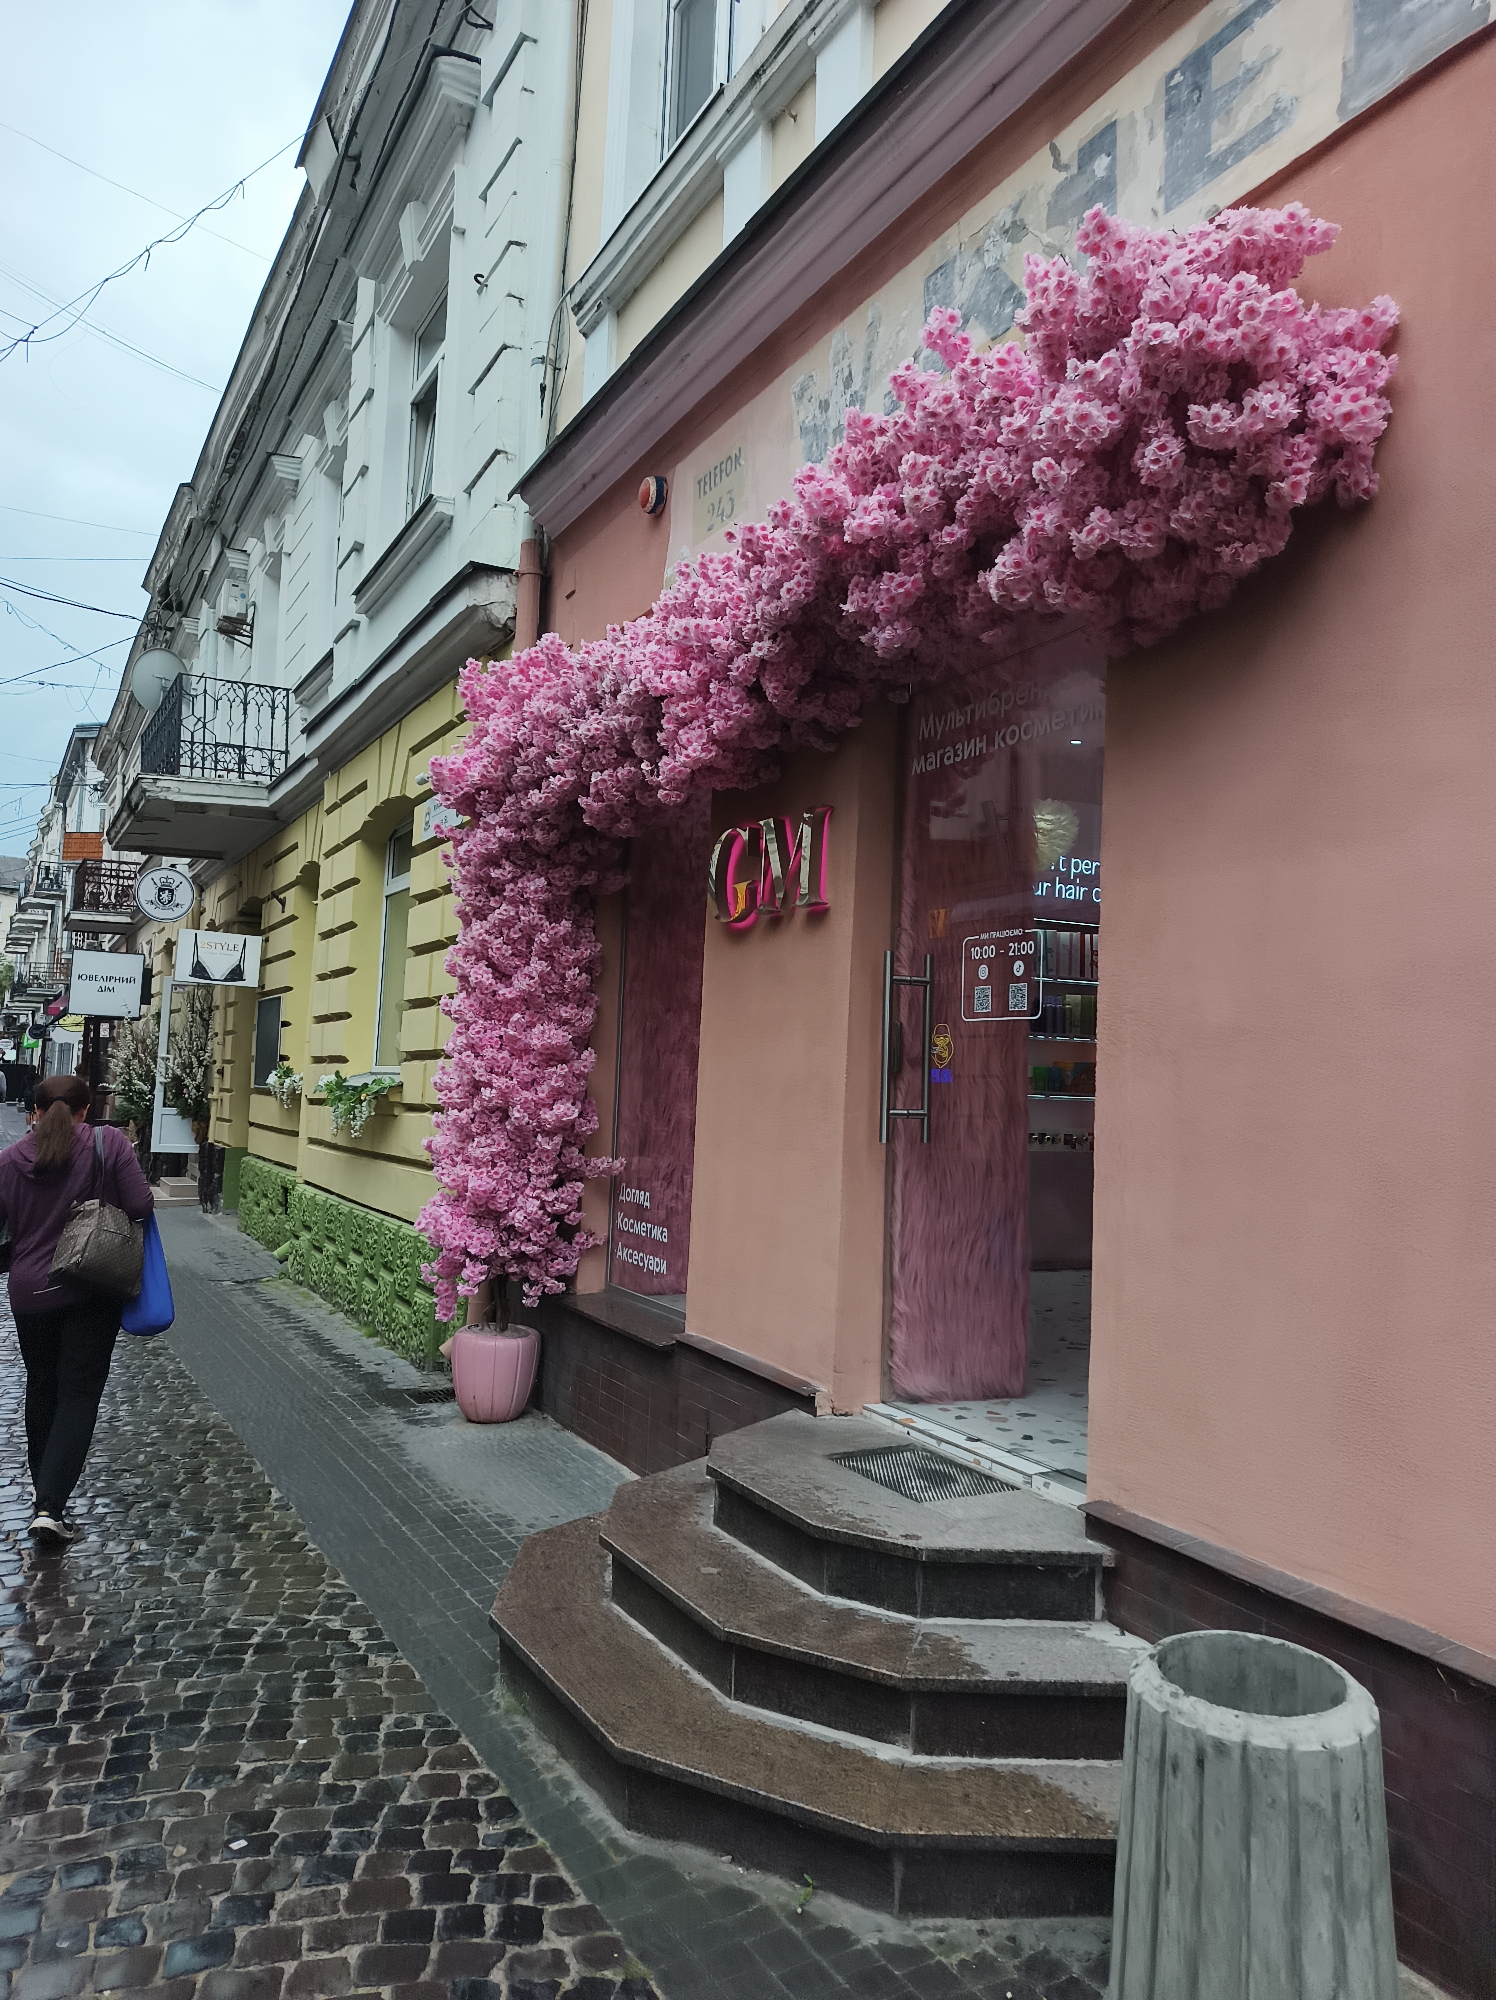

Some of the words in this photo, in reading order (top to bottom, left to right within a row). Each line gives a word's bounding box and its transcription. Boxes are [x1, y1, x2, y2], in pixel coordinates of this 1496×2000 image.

[697, 447, 742, 499] TELEFON
[919, 680, 1050, 741] Мультибрен
[912, 733, 987, 775] магазин
[994, 699, 1103, 750] косметик
[707, 805, 834, 923] GM
[1070, 857, 1101, 879] per
[1055, 877, 1089, 901] hair
[970, 944, 996, 960] 10:00
[1008, 940, 1035, 957] 21:00
[77, 973, 136, 985] ЮВЕЛІРНИЙ
[97, 985, 115, 994] ДІМ
[619, 1182, 650, 1209] Догляд
[617, 1211, 668, 1243] Косметика
[616, 1241, 667, 1276] Аксесуари
